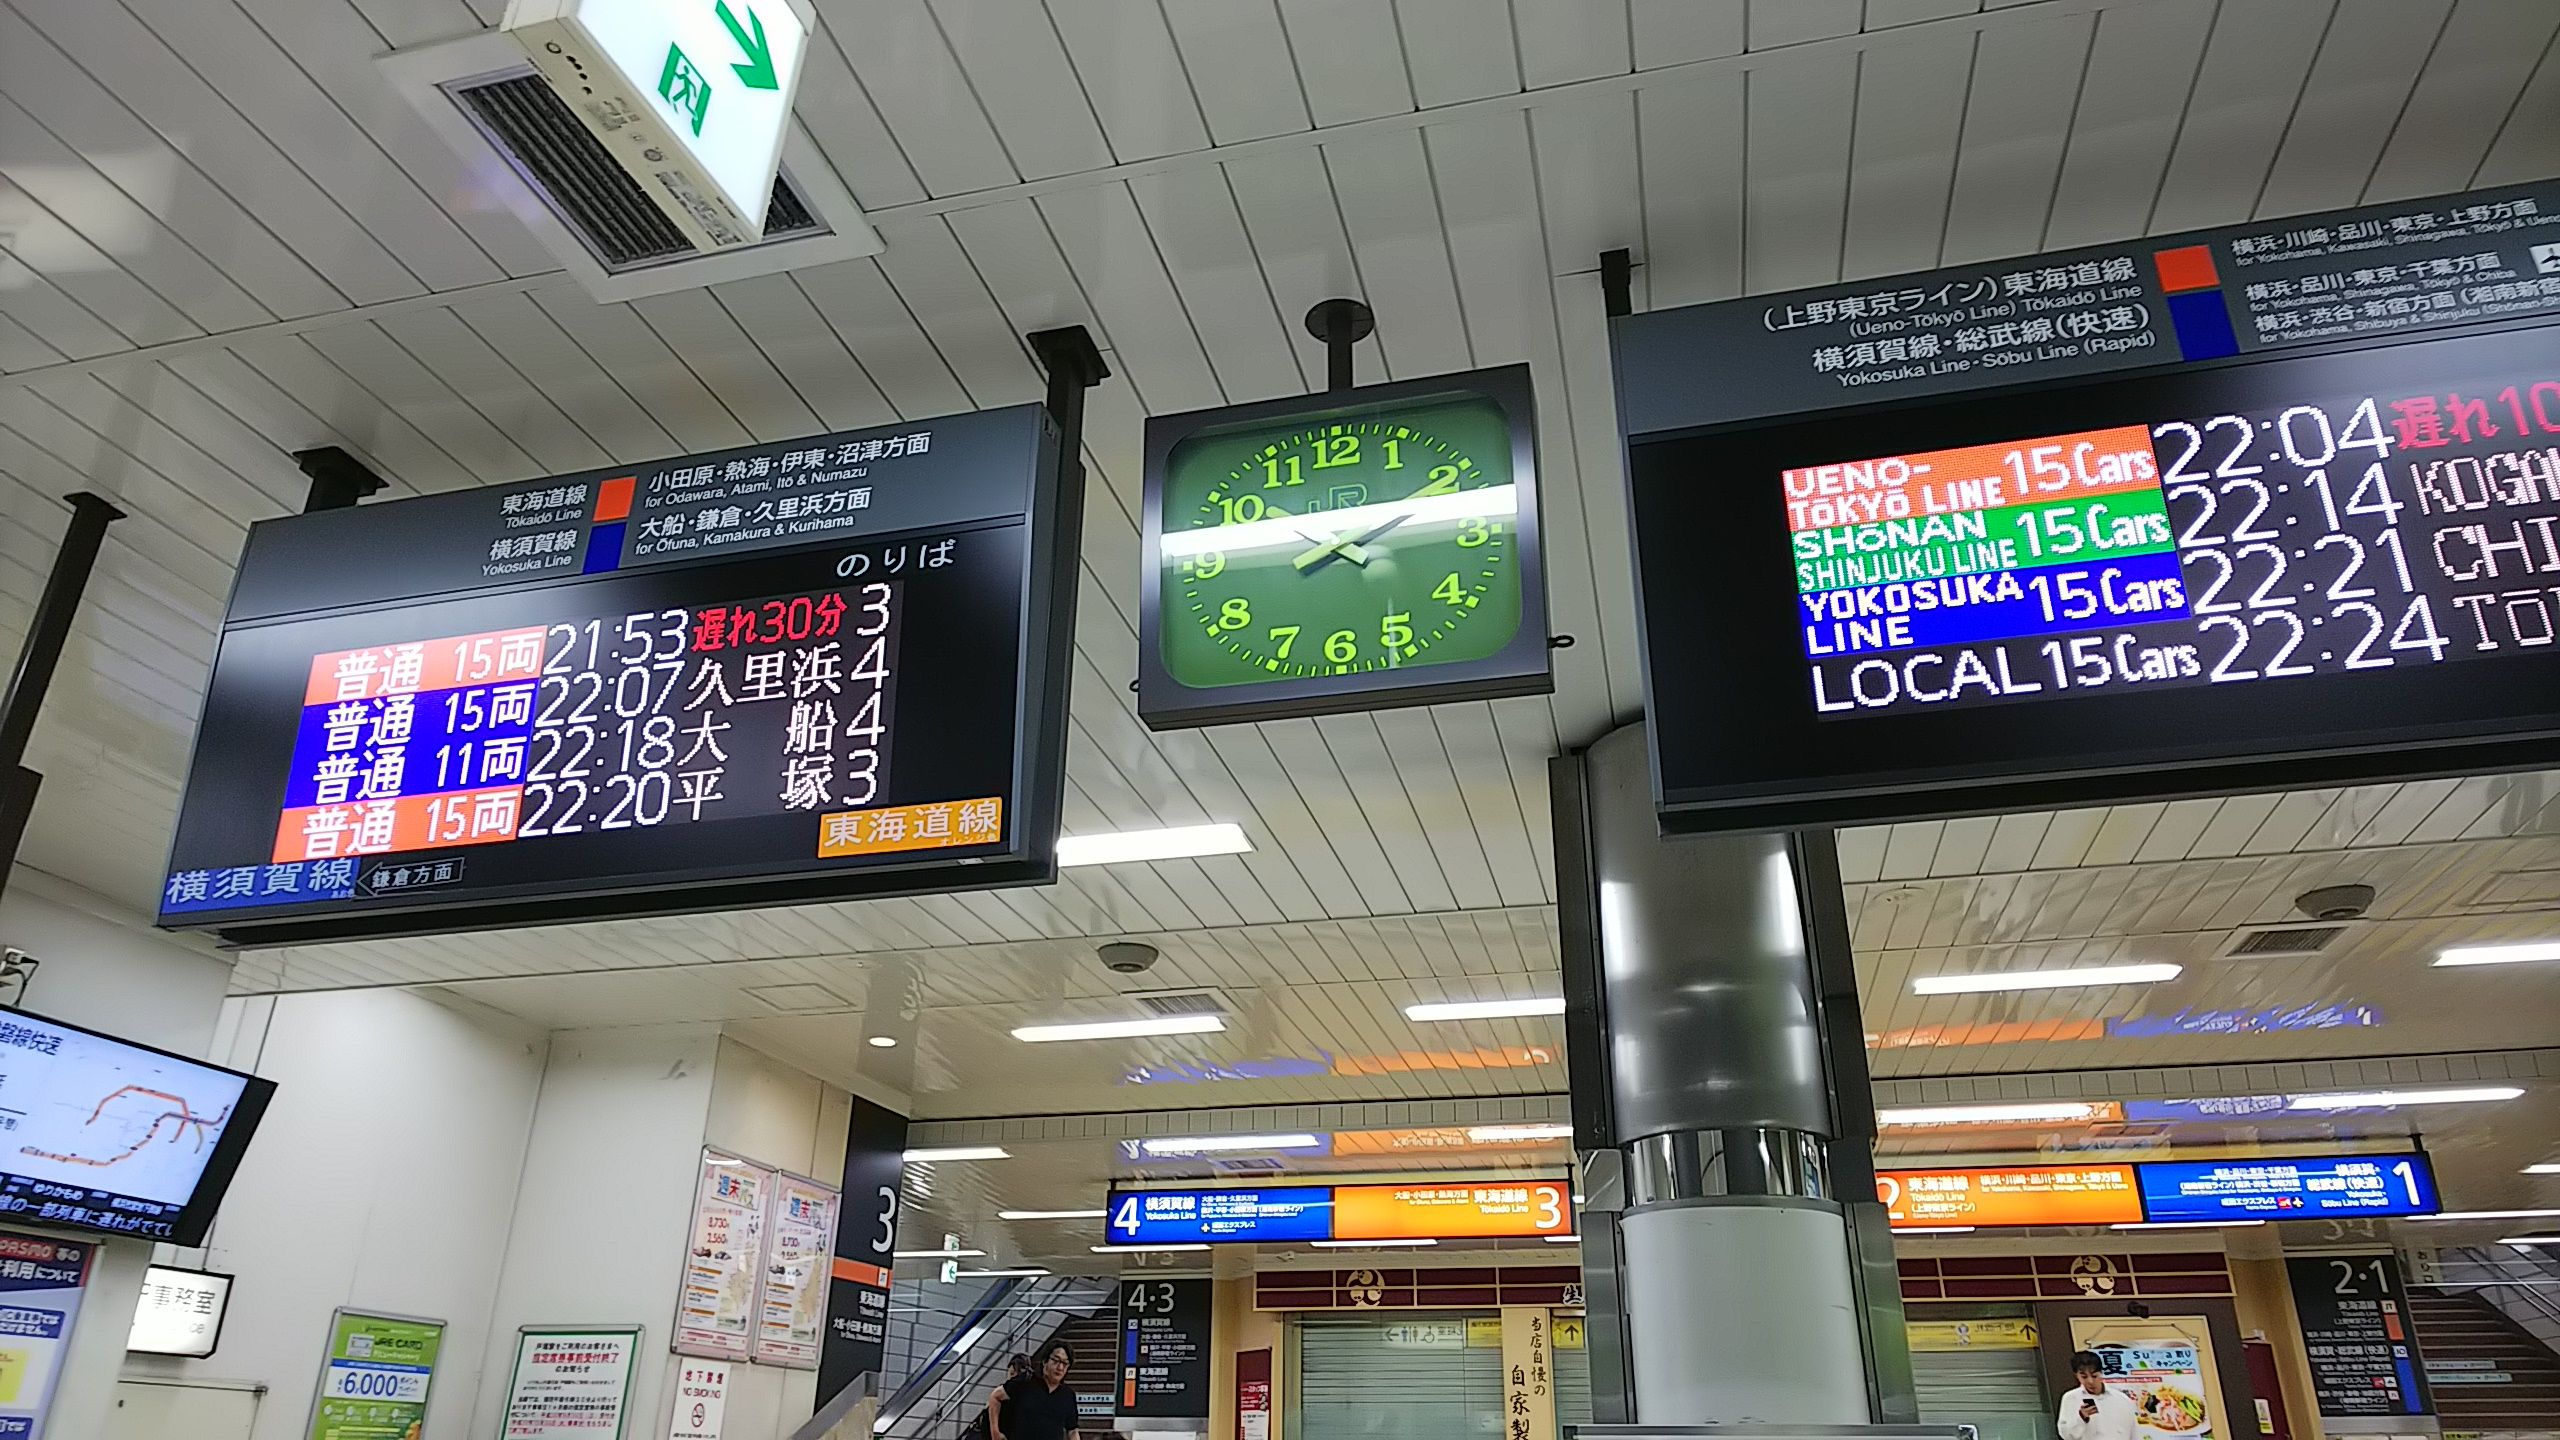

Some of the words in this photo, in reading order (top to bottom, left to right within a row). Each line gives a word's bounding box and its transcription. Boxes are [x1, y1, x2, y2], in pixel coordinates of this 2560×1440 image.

[2235, 256, 2254, 267] for
[2257, 247, 2326, 264] Yokohama,
[2513, 218, 2526, 228] &
[2245, 252, 2501, 301] 横浜・品川・東京・千葉方面
[2249, 303, 2268, 312] for
[2271, 293, 2341, 310] Yokohama,
[2462, 274, 2475, 284] &
[1850, 310, 1965, 338] (Ueno-Tōkyō
[1970, 300, 2017, 320] Line)
[2022, 291, 2096, 312] Tōkaidō
[2100, 285, 2143, 301] Line
[2254, 291, 2456, 333] 横浜・渋谷・新宿方面
[2259, 334, 2278, 344] for
[2280, 325, 2351, 341] Yokohama,
[2353, 316, 2407, 332] Shibuya
[2409, 313, 2420, 323] &
[1812, 303, 2149, 373] 横須賀線・総武線(快速)
[1837, 365, 1926, 387] Yokosuka
[2037, 344, 2079, 361] Line
[2084, 330, 2156, 355] (Rapid)
[648, 431, 932, 494] 小田原・熱海・伊東・沼津方面
[1311, 436, 1360, 470] 12
[1383, 440, 1404, 471] 1
[1783, 458, 1931, 499] UENO-
[2153, 397, 2396, 485] 22:04
[644, 494, 664, 509] for
[665, 487, 728, 506] Odawara,
[730, 480, 773, 496] Atami,
[776, 475, 793, 489] Itō
[797, 473, 807, 486] &
[811, 466, 868, 485] Numazu
[1263, 455, 1305, 489] 11
[1427, 465, 1460, 496] 2
[500, 484, 588, 515] 東海道線
[505, 511, 552, 528] Tōkaidō
[555, 508, 582, 522] Line
[637, 487, 873, 540] 大船・鎌倉・久里浜方面
[1218, 494, 1265, 526] 10
[1790, 488, 1911, 529] TŌKYŌ
[1921, 476, 2006, 514] LINE
[1793, 510, 1988, 560] SHŌNAN
[2167, 462, 2404, 549] 22:14
[489, 529, 578, 561] 横須賀線
[635, 541, 654, 556] for
[656, 534, 701, 552] Ōfuna,
[703, 525, 771, 547] Kamakura
[774, 523, 785, 536] &
[788, 513, 854, 534] Kurihama
[1456, 516, 1490, 547] 3
[482, 558, 541, 577] Yokosuka
[544, 554, 572, 568] Line
[836, 538, 956, 577] のりば
[1194, 551, 1226, 579] 9
[1799, 546, 1946, 592] SHINJUKU
[1952, 538, 2019, 573] LINE
[1802, 571, 2024, 621] YOKOSUKA
[2182, 527, 2415, 615] 22:21
[1431, 572, 1468, 605] 4
[1218, 598, 1251, 630] 8
[1380, 611, 1414, 647] 5
[1806, 614, 1914, 655] LINE
[333, 642, 425, 702] 普通
[454, 631, 545, 683] 15両
[542, 608, 690, 676] 21:53
[690, 592, 848, 652] 遅れ30分
[856, 582, 892, 636] 3
[1269, 625, 1301, 659] 7
[1324, 630, 1358, 663] 6
[1812, 646, 2042, 713] LOCAL
[2198, 594, 2450, 683] 22:24
[2452, 587, 2560, 651] TŌ
[322, 692, 416, 753] 普通
[445, 682, 536, 735] 15両
[534, 660, 686, 728] 22:07
[683, 641, 843, 711] 久里浜
[850, 635, 890, 690] 4
[312, 745, 406, 805] 普通
[436, 736, 528, 788] 11両
[526, 715, 676, 782] 22:18
[845, 690, 886, 746] 4
[302, 798, 396, 860] 普通
[426, 790, 520, 843] 15両
[517, 770, 672, 839] 22:20
[842, 748, 880, 806] 3
[823, 800, 998, 847] 東海道線
[165, 857, 352, 904] 横須賀線
[371, 862, 454, 890] 鎌倉方面
[1876, 1176, 1904, 1219] 2
[2392, 1161, 2420, 1206] 1
[872, 1187, 896, 1252] 3
[1114, 1197, 1140, 1236] 4
[1535, 1187, 1561, 1229] 3
[0, 1259, 79, 1283] 利用について
[396, 1338, 423, 1350] CARD
[1530, 1316, 1547, 1396] 当店自慢の
[344, 1372, 398, 1396] 6,000
[1509, 1365, 1530, 1440] 自家製
